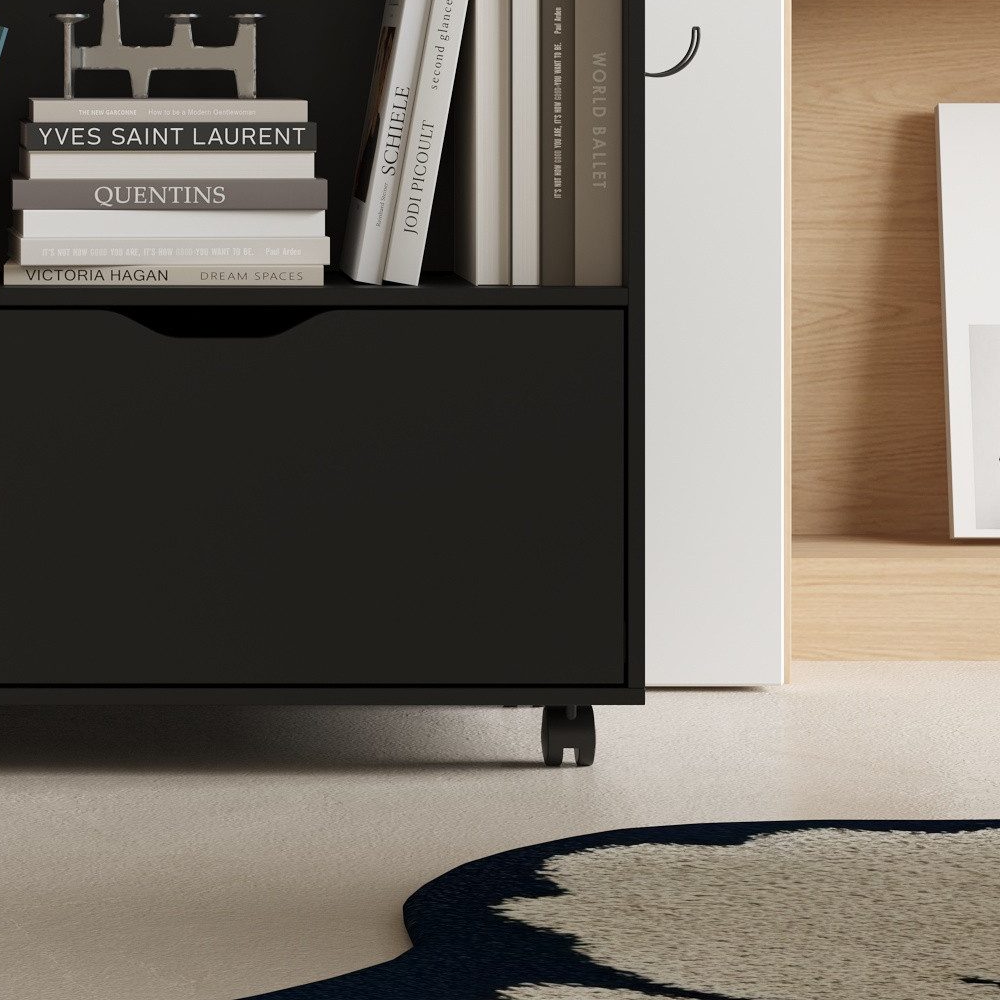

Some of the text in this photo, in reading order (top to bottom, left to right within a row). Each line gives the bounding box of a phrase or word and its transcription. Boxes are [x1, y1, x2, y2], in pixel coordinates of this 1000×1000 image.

[429, 0, 453, 91] second glance
[38, 127, 306, 146] YVES SAINT LAURENT
[381, 86, 411, 176] SCHIELE
[592, 51, 607, 189] WORLD BALLET
[94, 186, 226, 207] QUENTINS
[403, 119, 436, 235] JODI PICOULT
[26, 269, 169, 282] VICTORIA HAGAN
[200, 271, 303, 281] DREAM SPACES
